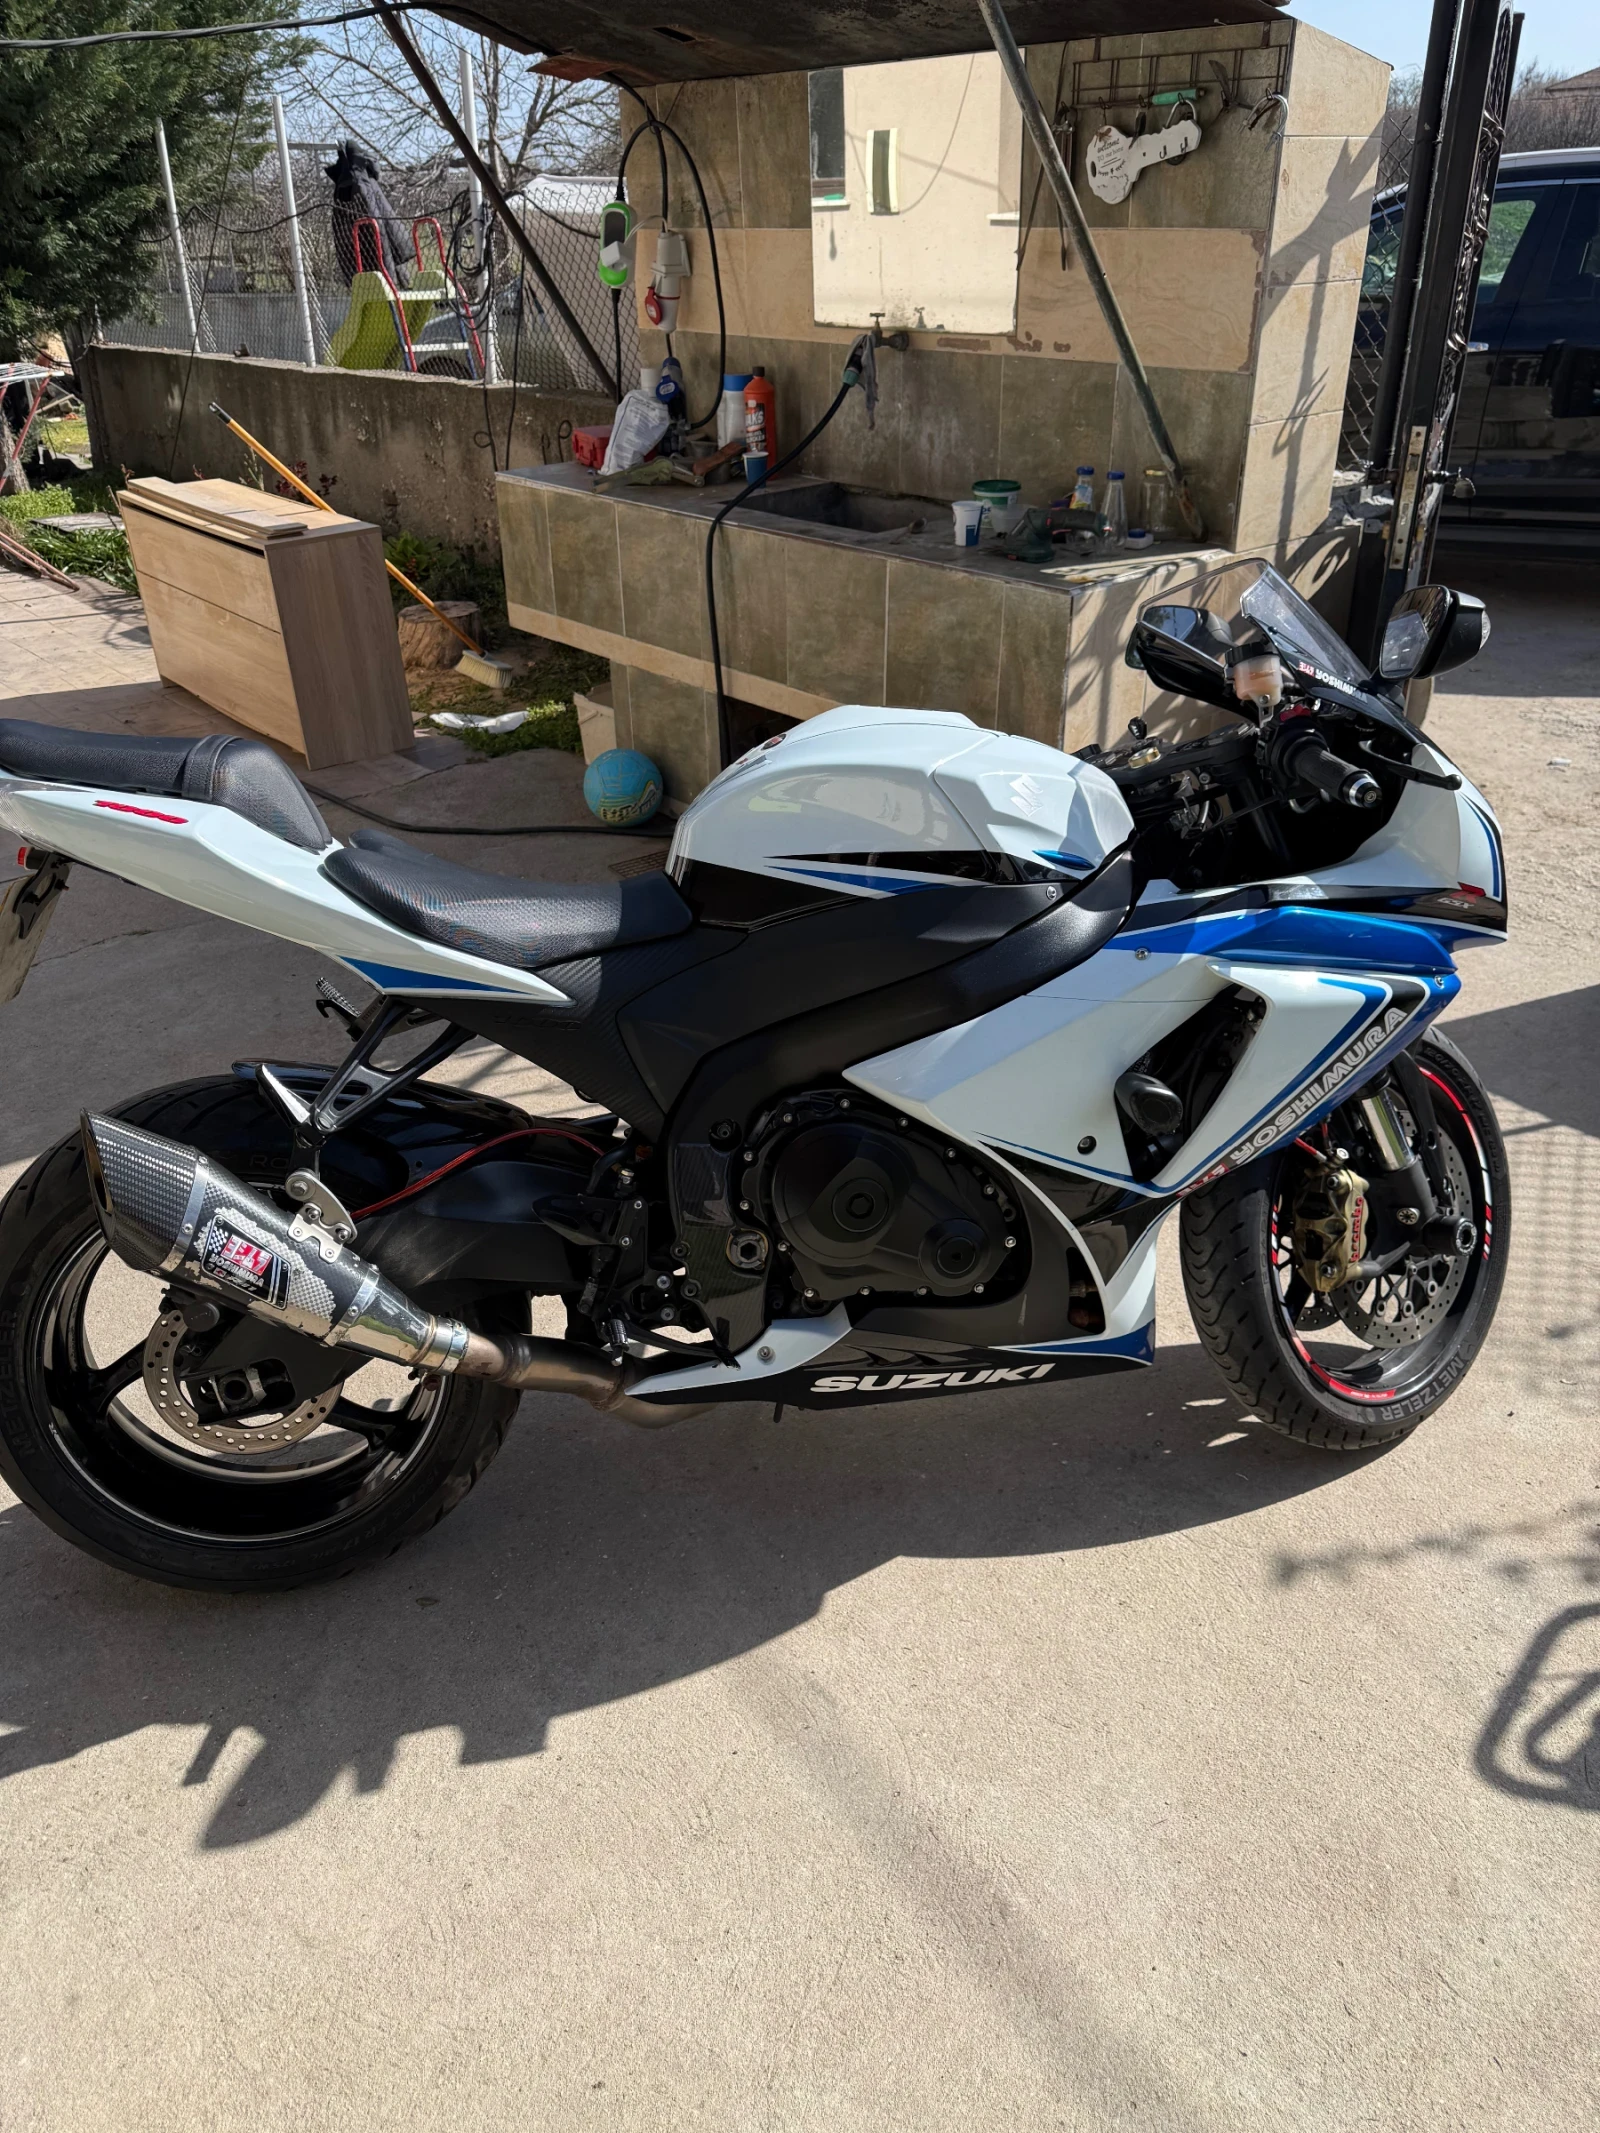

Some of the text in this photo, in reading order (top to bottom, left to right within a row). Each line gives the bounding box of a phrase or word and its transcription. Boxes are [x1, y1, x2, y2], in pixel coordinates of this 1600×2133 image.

[1314, 667, 1369, 705] YOSHIMURA
[1229, 1006, 1408, 1165] YOSHIMURA
[1349, 1195, 1365, 1263] brembo
[208, 1253, 265, 1288] YOSHIMURA
[810, 1363, 1057, 1393] SUZUKI
[1380, 1355, 1469, 1421] METZELER
